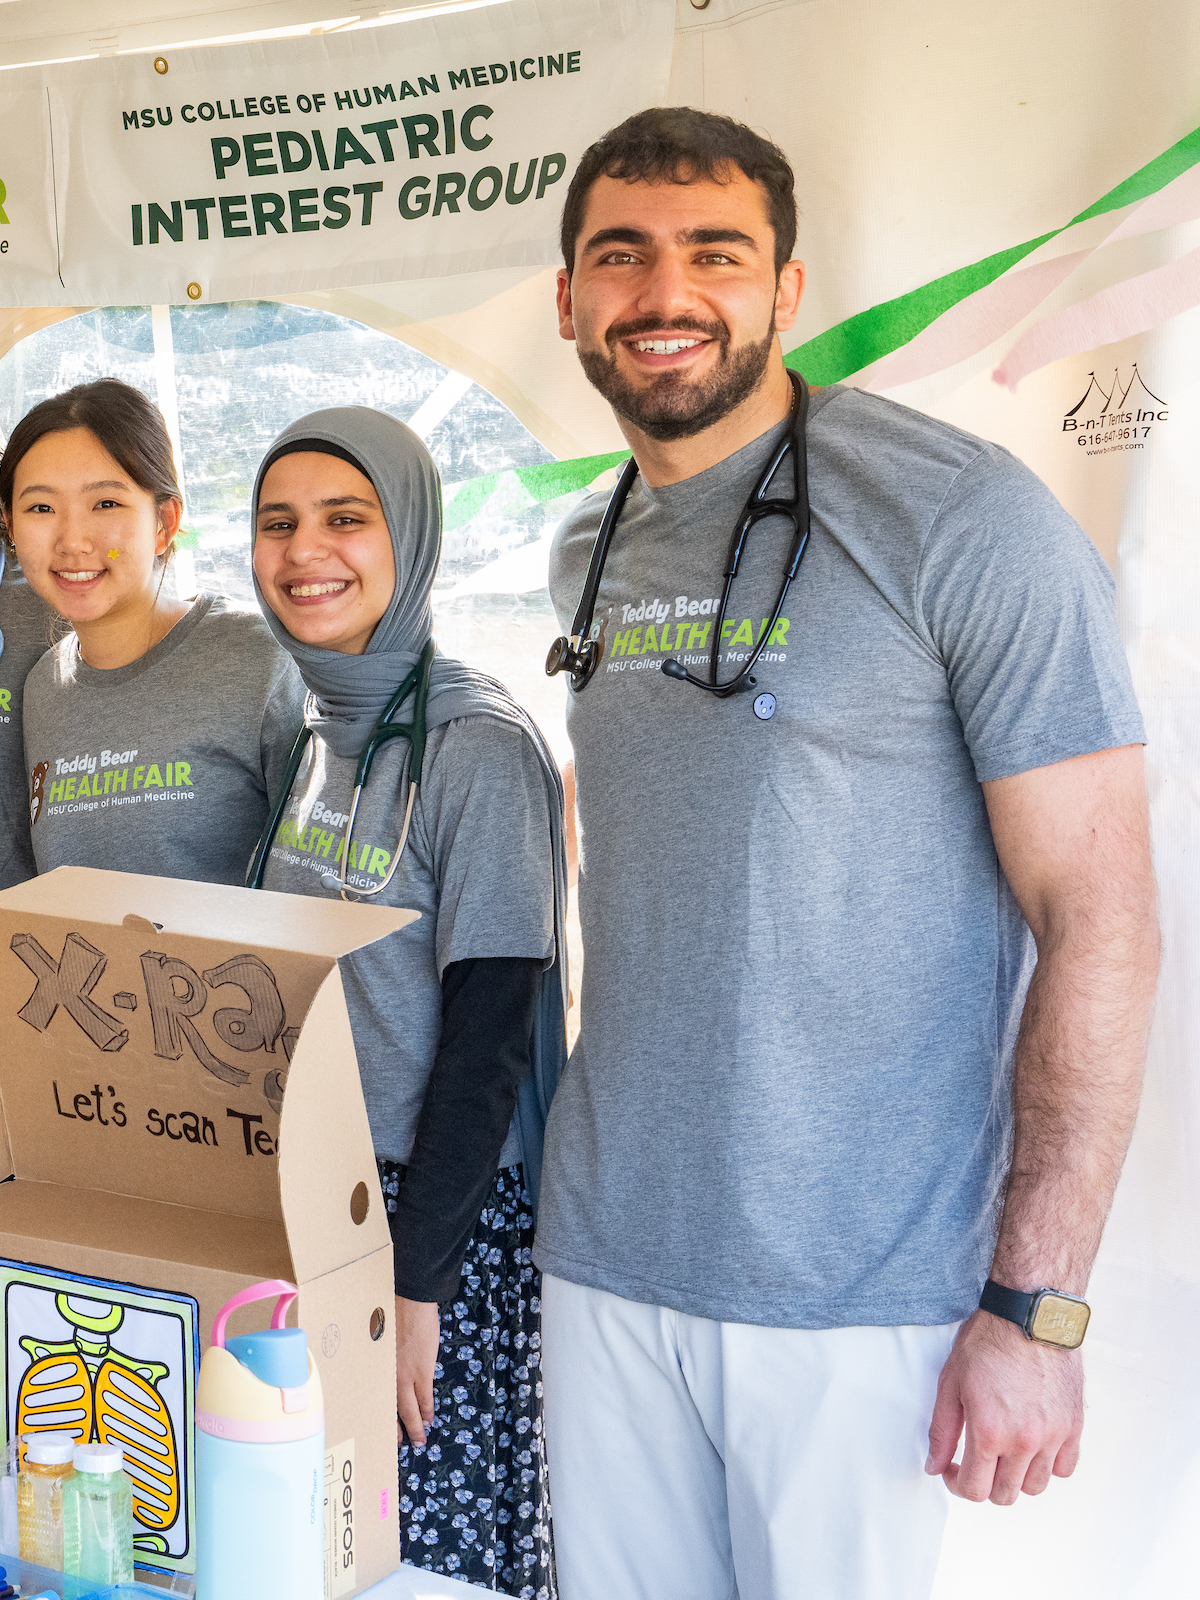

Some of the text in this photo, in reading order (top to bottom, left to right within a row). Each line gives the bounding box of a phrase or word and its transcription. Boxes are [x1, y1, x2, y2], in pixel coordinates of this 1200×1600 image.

[122, 49, 582, 131] MSU COLLEGE OF HUMAN MEDICINE
[210, 104, 495, 180] PEDIATRIC
[131, 152, 567, 247] INTEREST GROUP
[1062, 408, 1169, 432] B-n-T Tents Inc
[1077, 426, 1152, 446] 616-647-9617
[622, 596, 721, 624] Teddy Bear
[610, 617, 790, 658] HEALTH FAIR
[630, 659, 664, 670] Colleg
[684, 655, 722, 665] Humn
[726, 651, 787, 662] Medcine
[55, 750, 138, 775] Teddy Bear
[49, 762, 193, 803] HEALTH FAIR
[68, 802, 98, 811] College
[101, 798, 109, 807] of
[111, 796, 141, 806] Human
[144, 791, 195, 802] Medicine
[312, 801, 350, 828] Bear
[302, 858, 311, 867] of
[310, 860, 339, 877] Human
[346, 874, 378, 888] edicin
[53, 1080, 279, 1156] Let's scan Te
[342, 1459, 353, 1569] OOFOS
